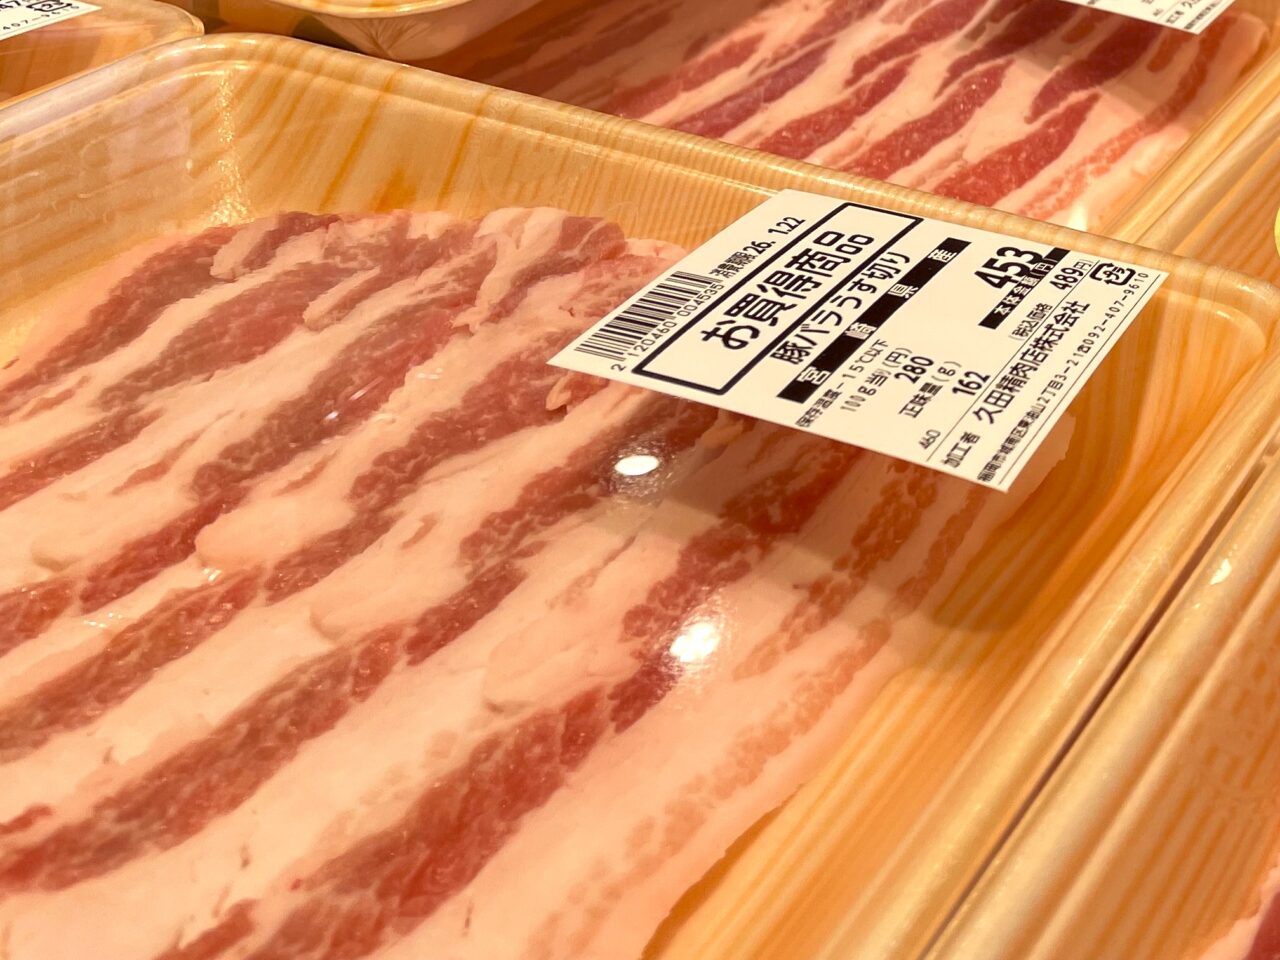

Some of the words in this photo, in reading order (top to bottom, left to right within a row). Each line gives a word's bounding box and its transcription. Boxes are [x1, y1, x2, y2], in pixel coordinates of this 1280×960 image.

[701, 230, 874, 350] お買得商品
[974, 246, 1044, 290] 453
[771, 251, 911, 365] 豚バラうす切り
[894, 355, 935, 385] 280
[943, 431, 981, 469] 加工者
[974, 300, 1090, 424] 久田精肉店株式会社
[952, 370, 991, 397] 162
